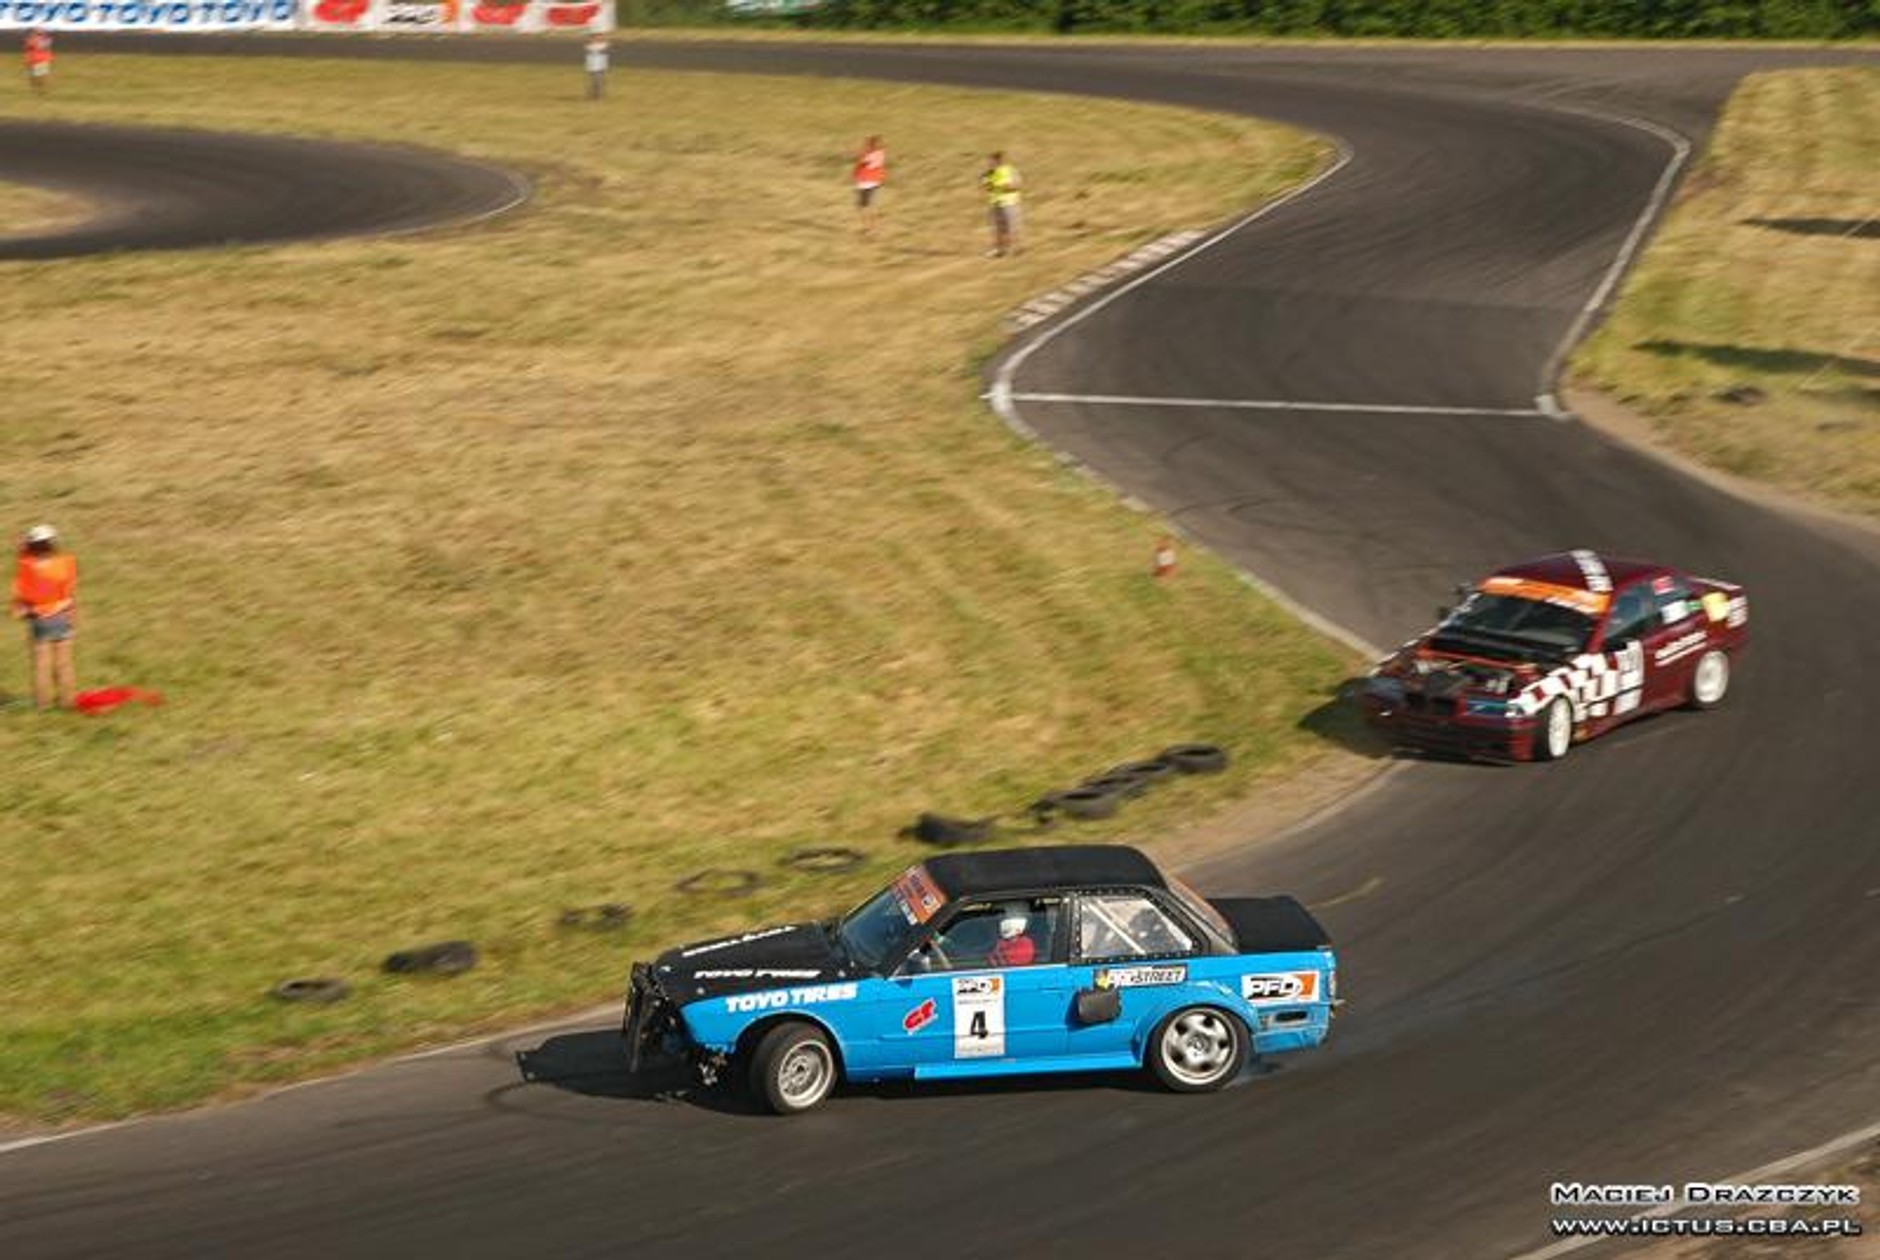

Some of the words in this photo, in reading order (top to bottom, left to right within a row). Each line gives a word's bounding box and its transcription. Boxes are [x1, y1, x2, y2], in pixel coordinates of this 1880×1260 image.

[725, 988, 790, 1013] TOYO
[790, 982, 858, 1003] TIRES
[970, 1010, 989, 1040] 4
